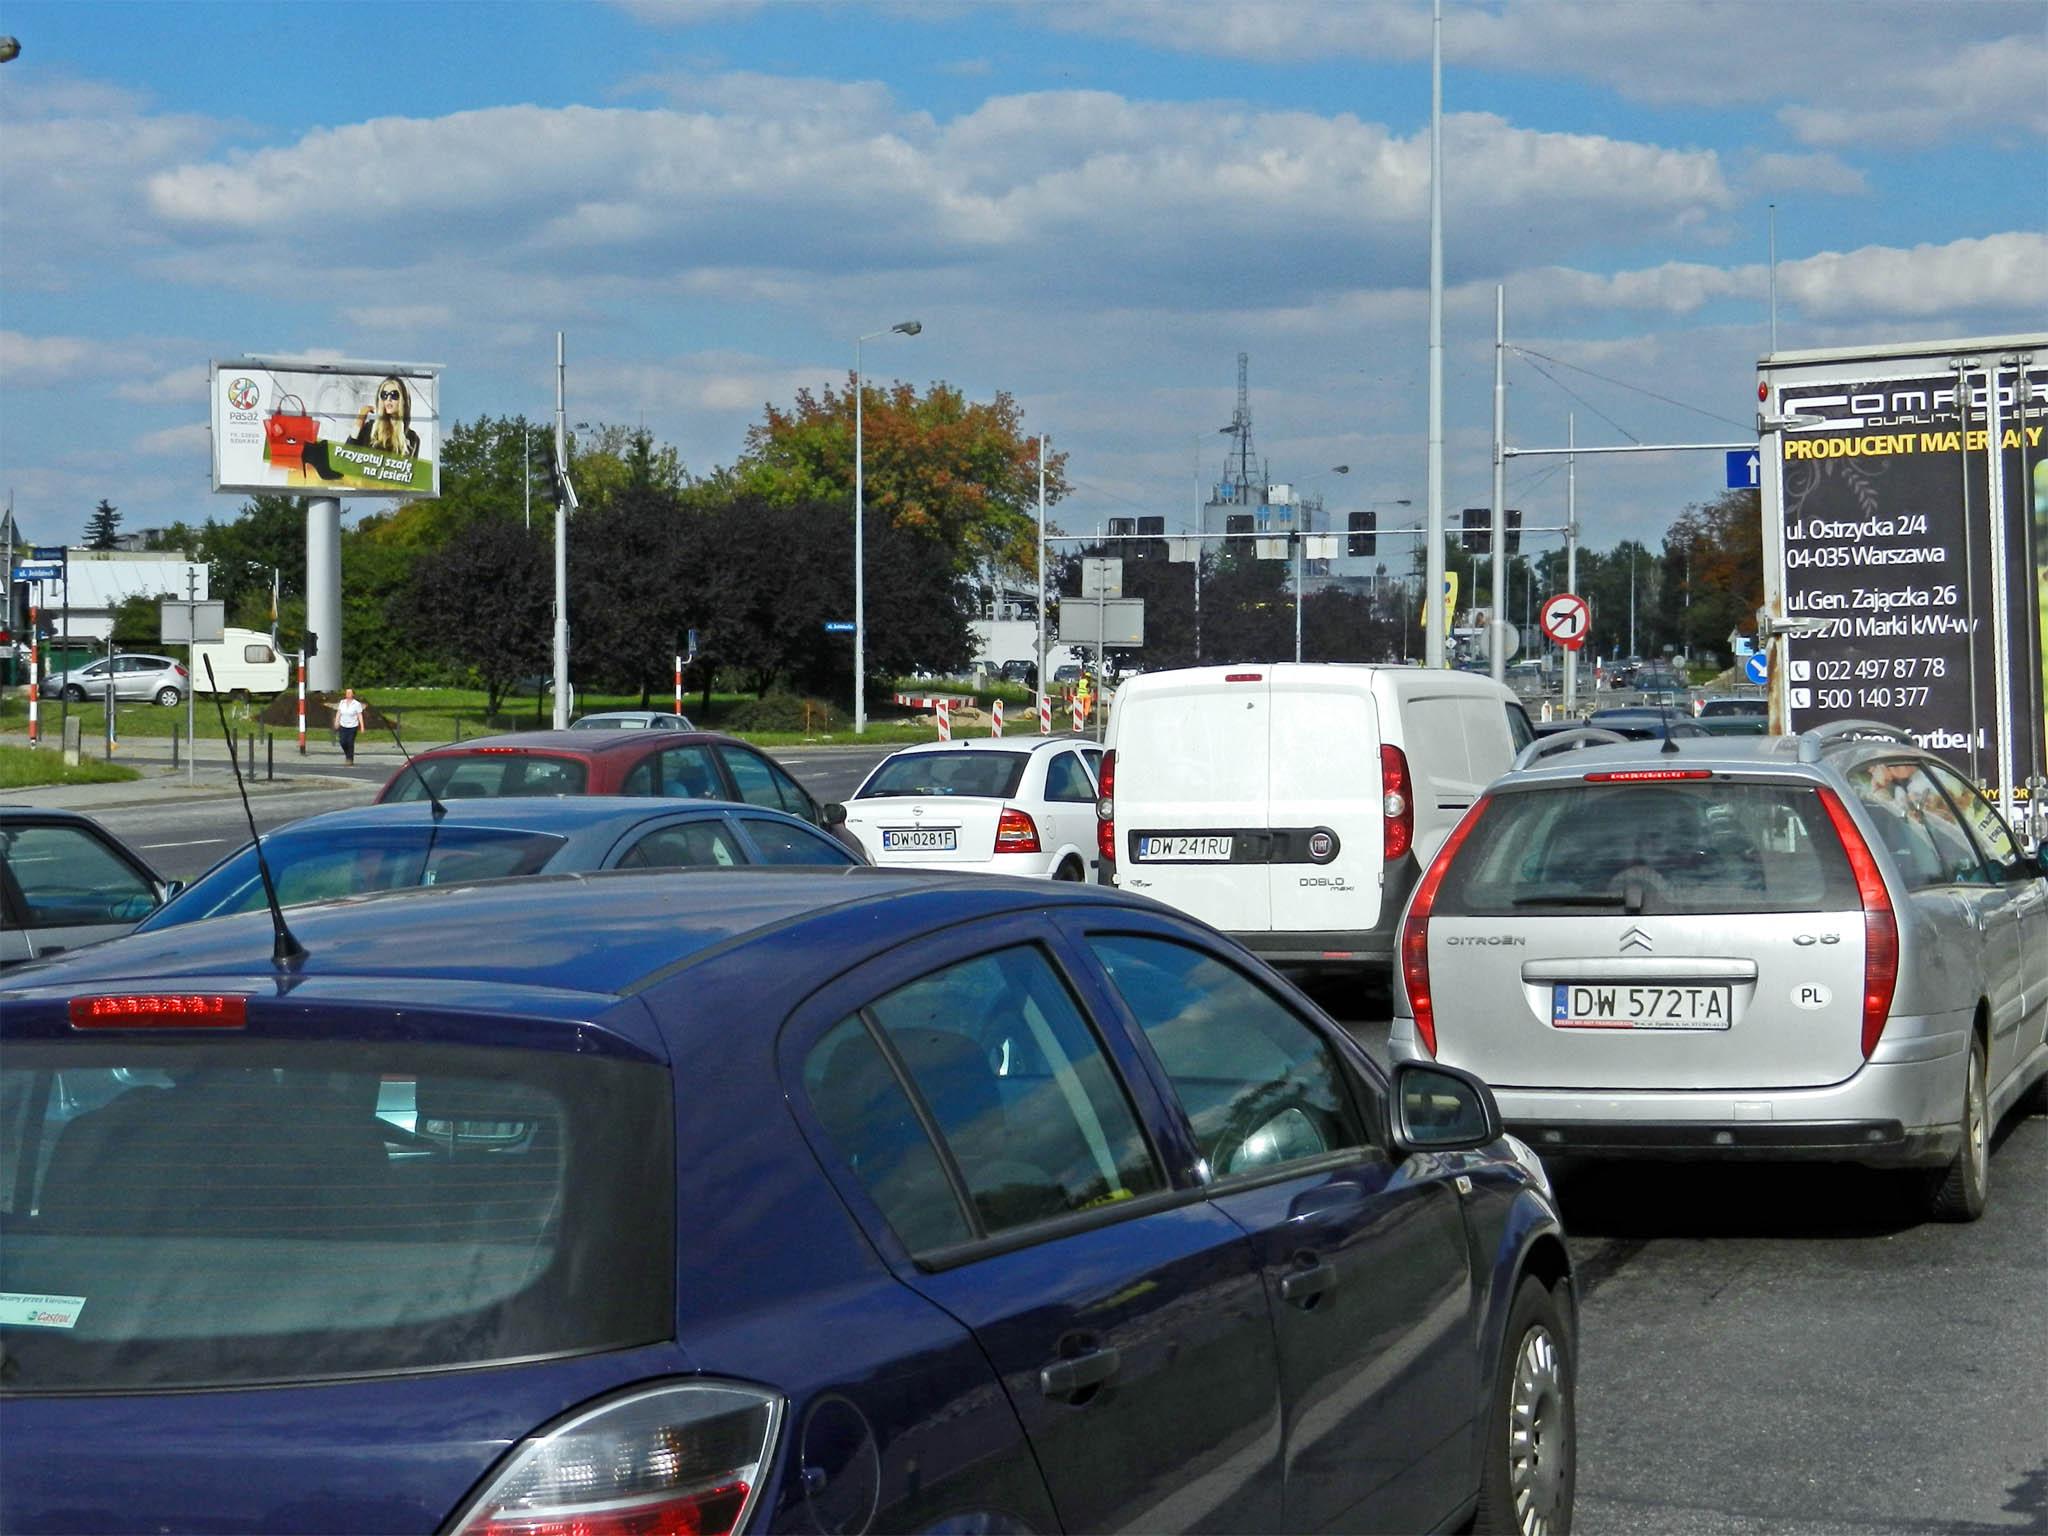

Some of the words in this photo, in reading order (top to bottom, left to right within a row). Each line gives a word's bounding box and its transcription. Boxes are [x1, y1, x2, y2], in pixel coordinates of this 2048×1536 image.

[334, 446, 384, 467] Przygotuj
[1784, 434, 1916, 460] PRODUCENT
[363, 466, 377, 476] na
[1787, 520, 1807, 541] ul.
[1809, 516, 1894, 543] Ostrzycka
[1897, 514, 1928, 536] 2/4
[1787, 547, 1850, 569] 04-035
[1851, 546, 1945, 566] Warszawa
[1852, 586, 1929, 613] Zajączka
[1932, 585, 1957, 606] 26
[1856, 615, 1907, 637] Marki
[1816, 660, 1850, 681] 022
[1855, 659, 1890, 680] 497
[1893, 658, 1919, 679] 87
[1921, 657, 1946, 678] 78
[1817, 689, 1851, 709] 500
[1857, 687, 1891, 708] 140
[1894, 686, 1929, 707] 377
[891, 832, 909, 846] DW
[913, 832, 953, 846] 0281F
[1150, 838, 1174, 855] DW
[1179, 838, 1230, 855] 241RU
[1299, 877, 1345, 887] DOBLO
[1573, 987, 1617, 1017] DW
[1629, 988, 1723, 1019] 572TA
[1801, 988, 1823, 1003] PL
[1555, 1006, 1567, 1015] PL
